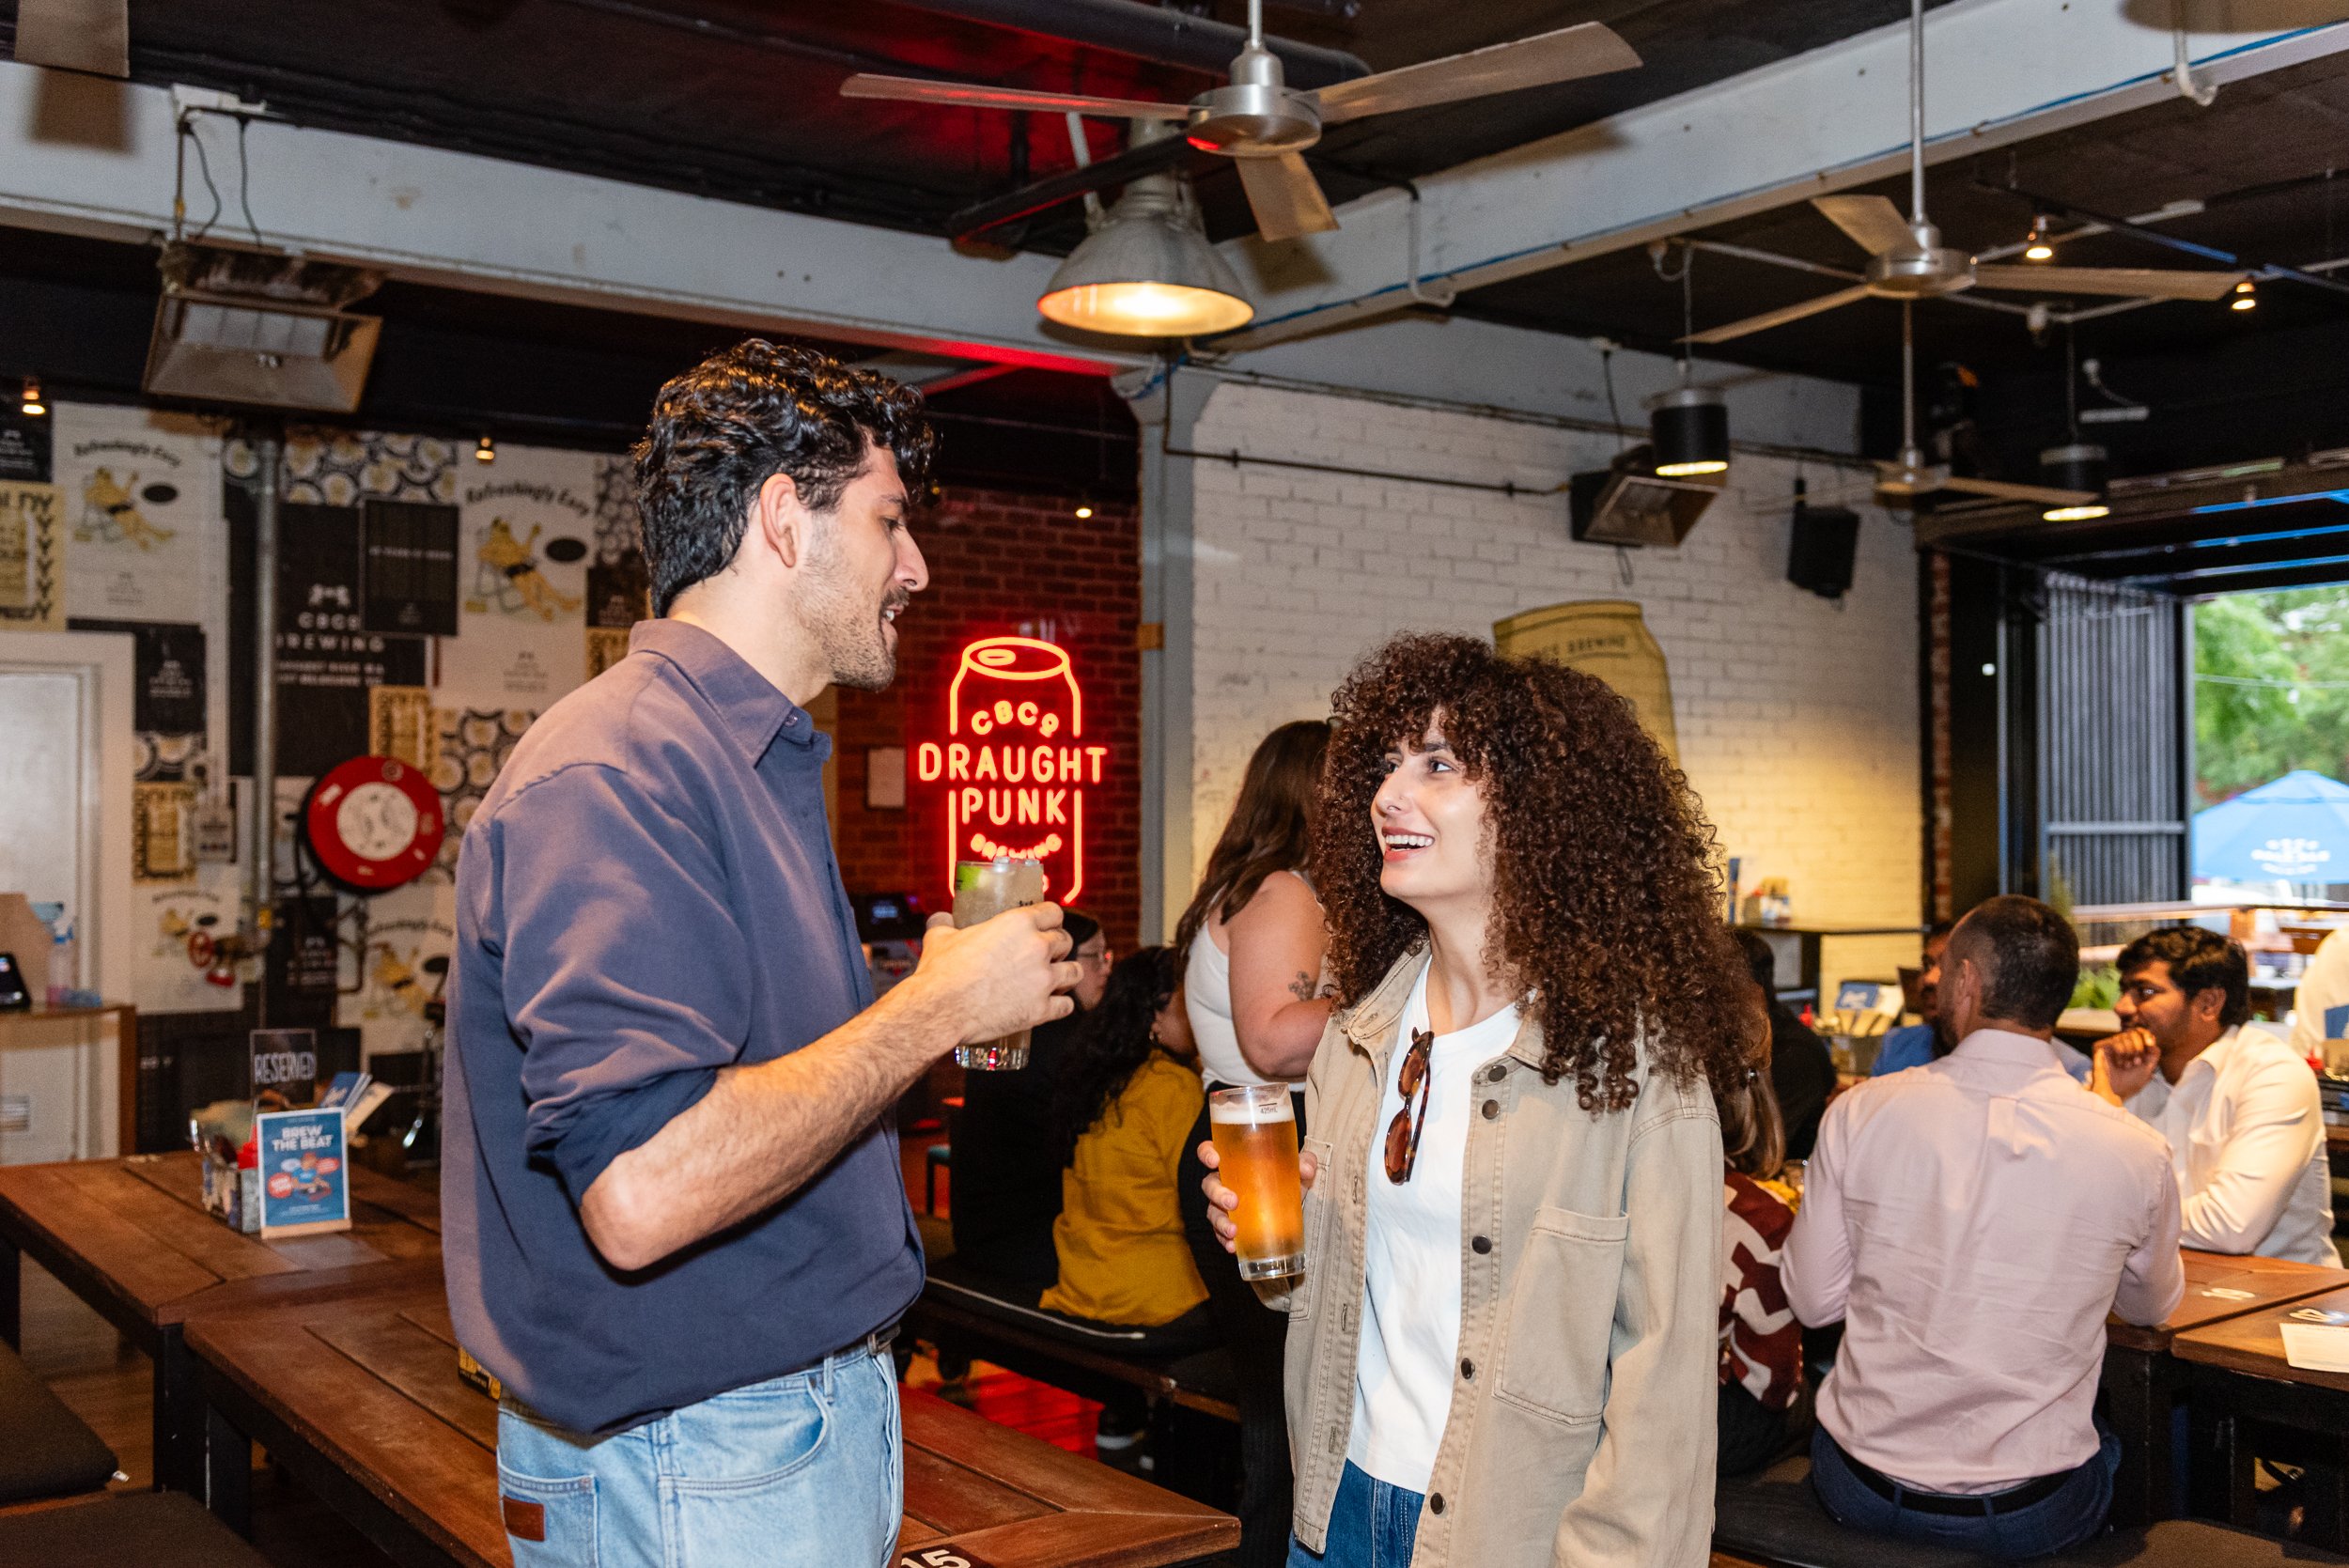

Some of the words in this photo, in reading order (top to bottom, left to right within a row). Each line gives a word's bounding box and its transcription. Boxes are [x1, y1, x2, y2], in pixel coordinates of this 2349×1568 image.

[917, 741, 1109, 784] DRAUGHT
[960, 786, 1067, 826] PUNK
[255, 1051, 317, 1084] RESERVED
[272, 1138, 298, 1152] THE
[300, 1134, 334, 1150] BEAT
[281, 1125, 323, 1141] BREW
